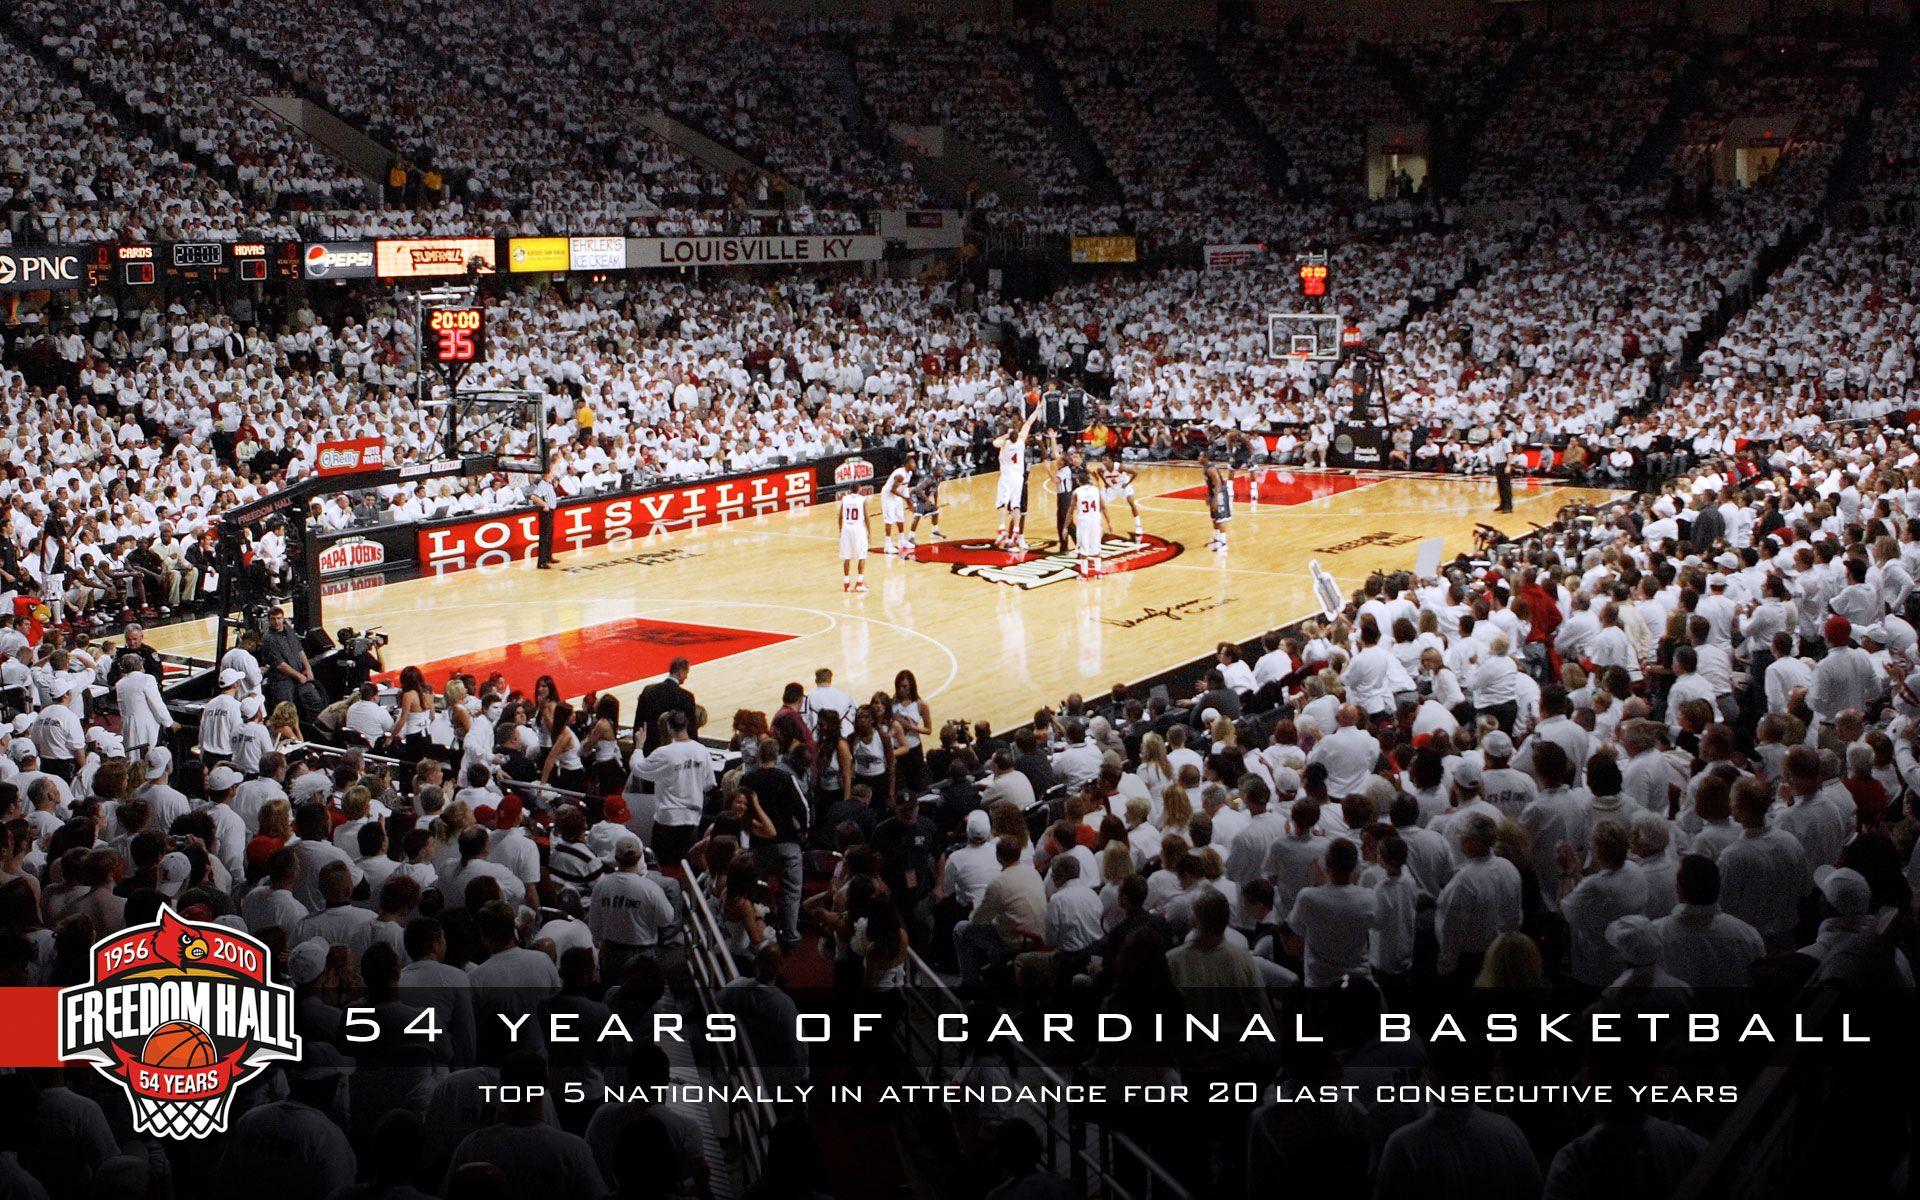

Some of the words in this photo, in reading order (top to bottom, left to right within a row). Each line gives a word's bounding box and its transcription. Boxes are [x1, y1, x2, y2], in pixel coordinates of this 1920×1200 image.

[119, 247, 153, 259] CARDS
[572, 238, 623, 252] EHRLER'S
[660, 240, 809, 263] LOUISVILLE
[823, 238, 853, 258] KY
[176, 246, 220, 263] 20:00
[325, 252, 373, 268] PEPSI
[574, 255, 588, 268] ICE
[589, 254, 620, 267] CREAM
[20, 256, 79, 281] PNC
[431, 311, 480, 329] 20:00
[440, 329, 474, 358] 35
[1010, 452, 1018, 464] 4
[846, 508, 859, 520] 10
[1081, 500, 1096, 513] 34
[428, 471, 811, 559] LOUISVILLE
[321, 548, 347, 570] PAPA
[349, 544, 382, 566] JOHNS
